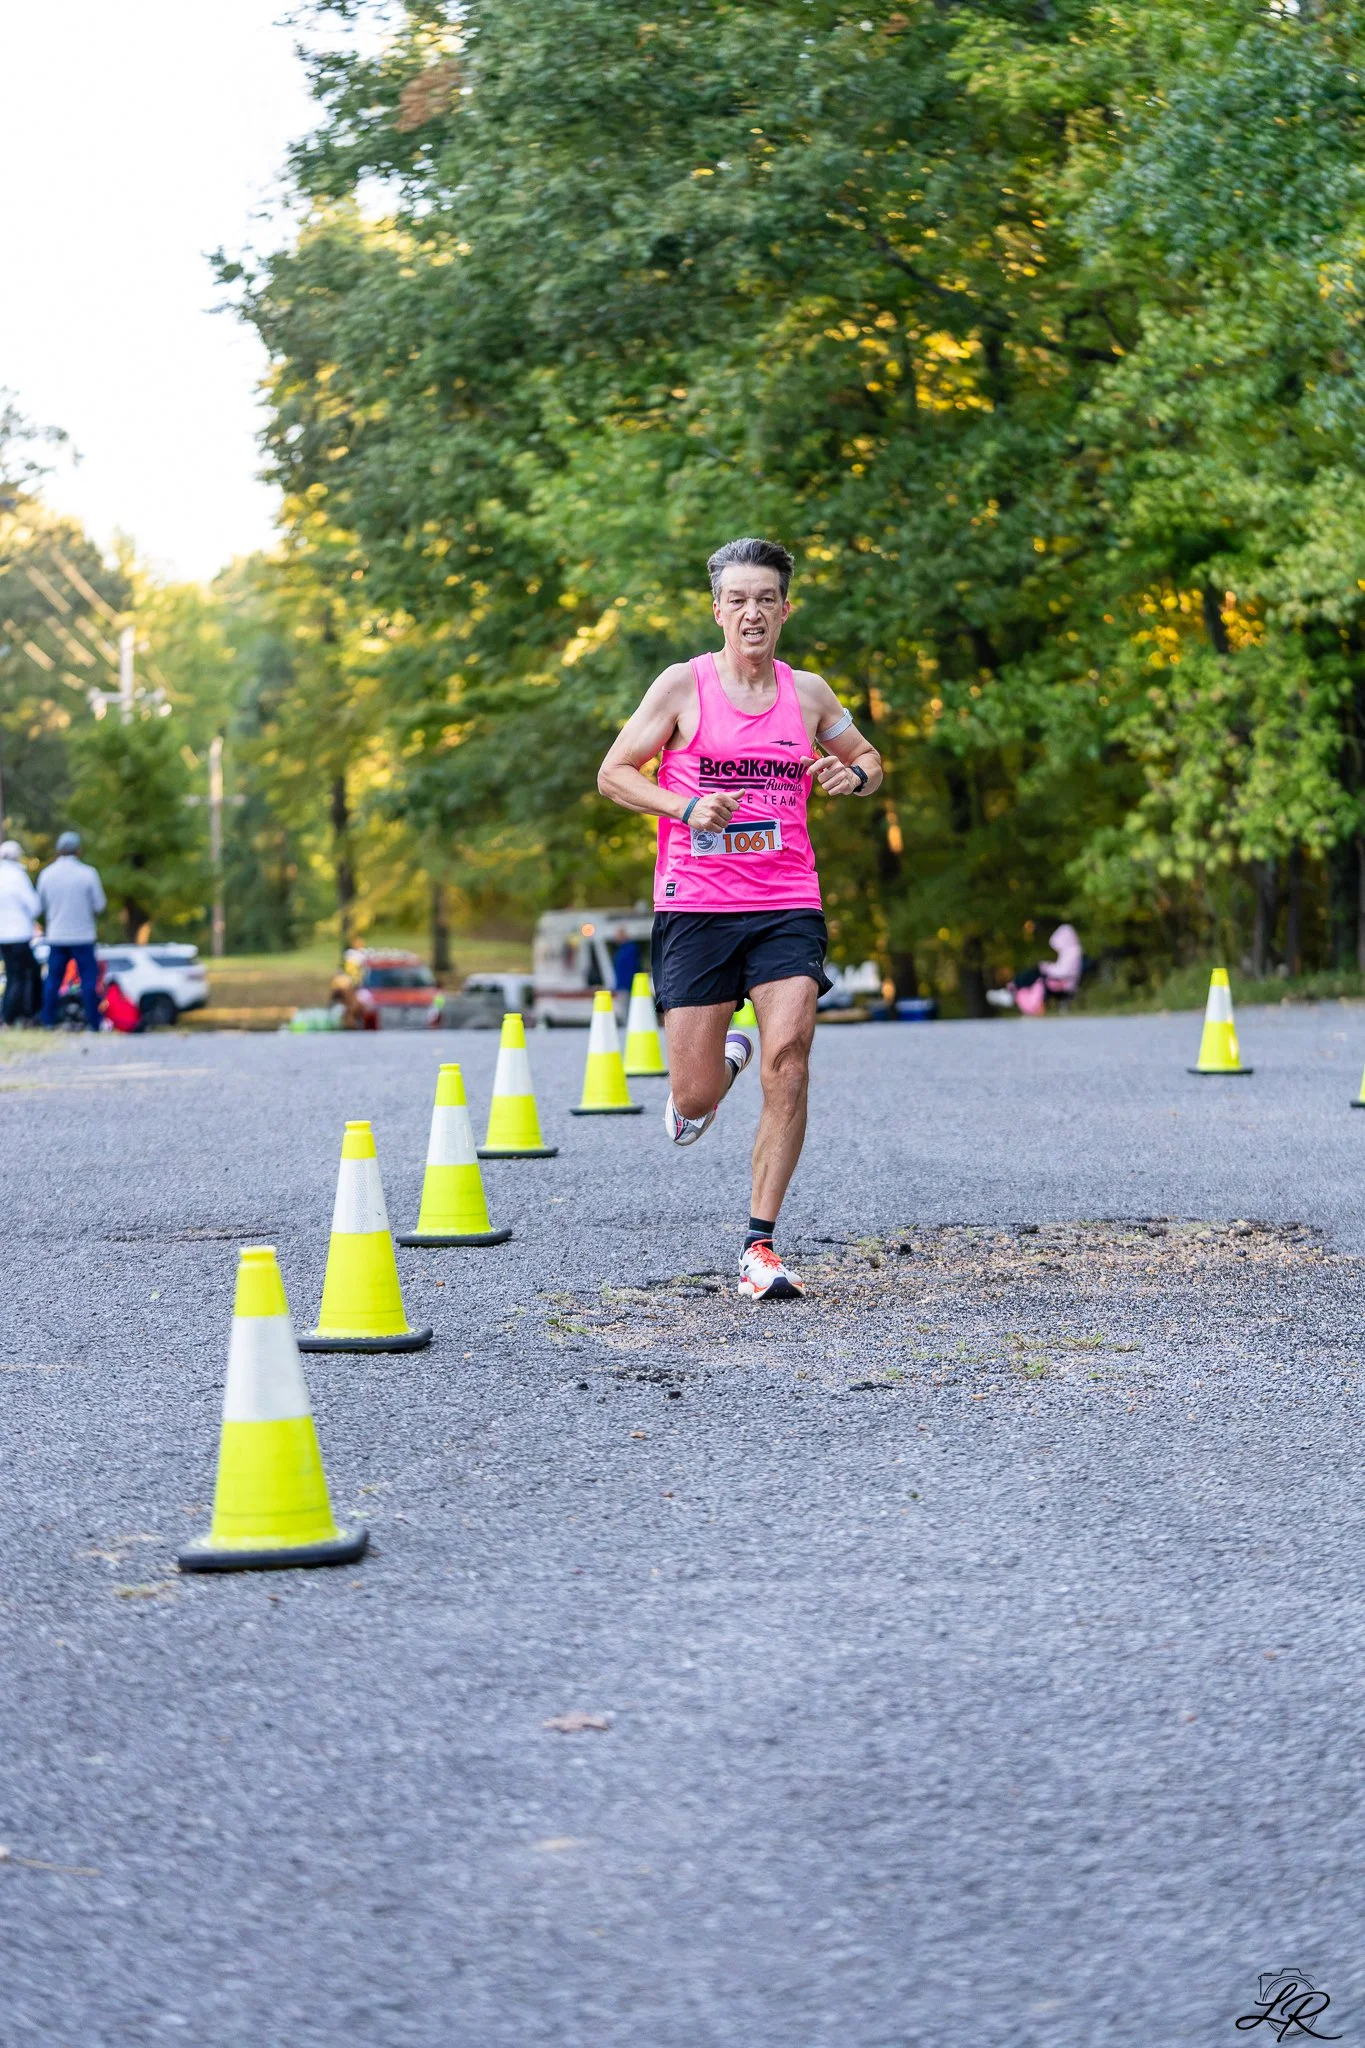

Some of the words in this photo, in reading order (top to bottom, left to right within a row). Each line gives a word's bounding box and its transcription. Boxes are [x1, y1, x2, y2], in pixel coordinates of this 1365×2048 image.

[699, 757, 807, 783] Breakaway
[765, 779, 803, 795] Running
[763, 794, 796, 806] TEAM
[723, 830, 775, 853] 1061
